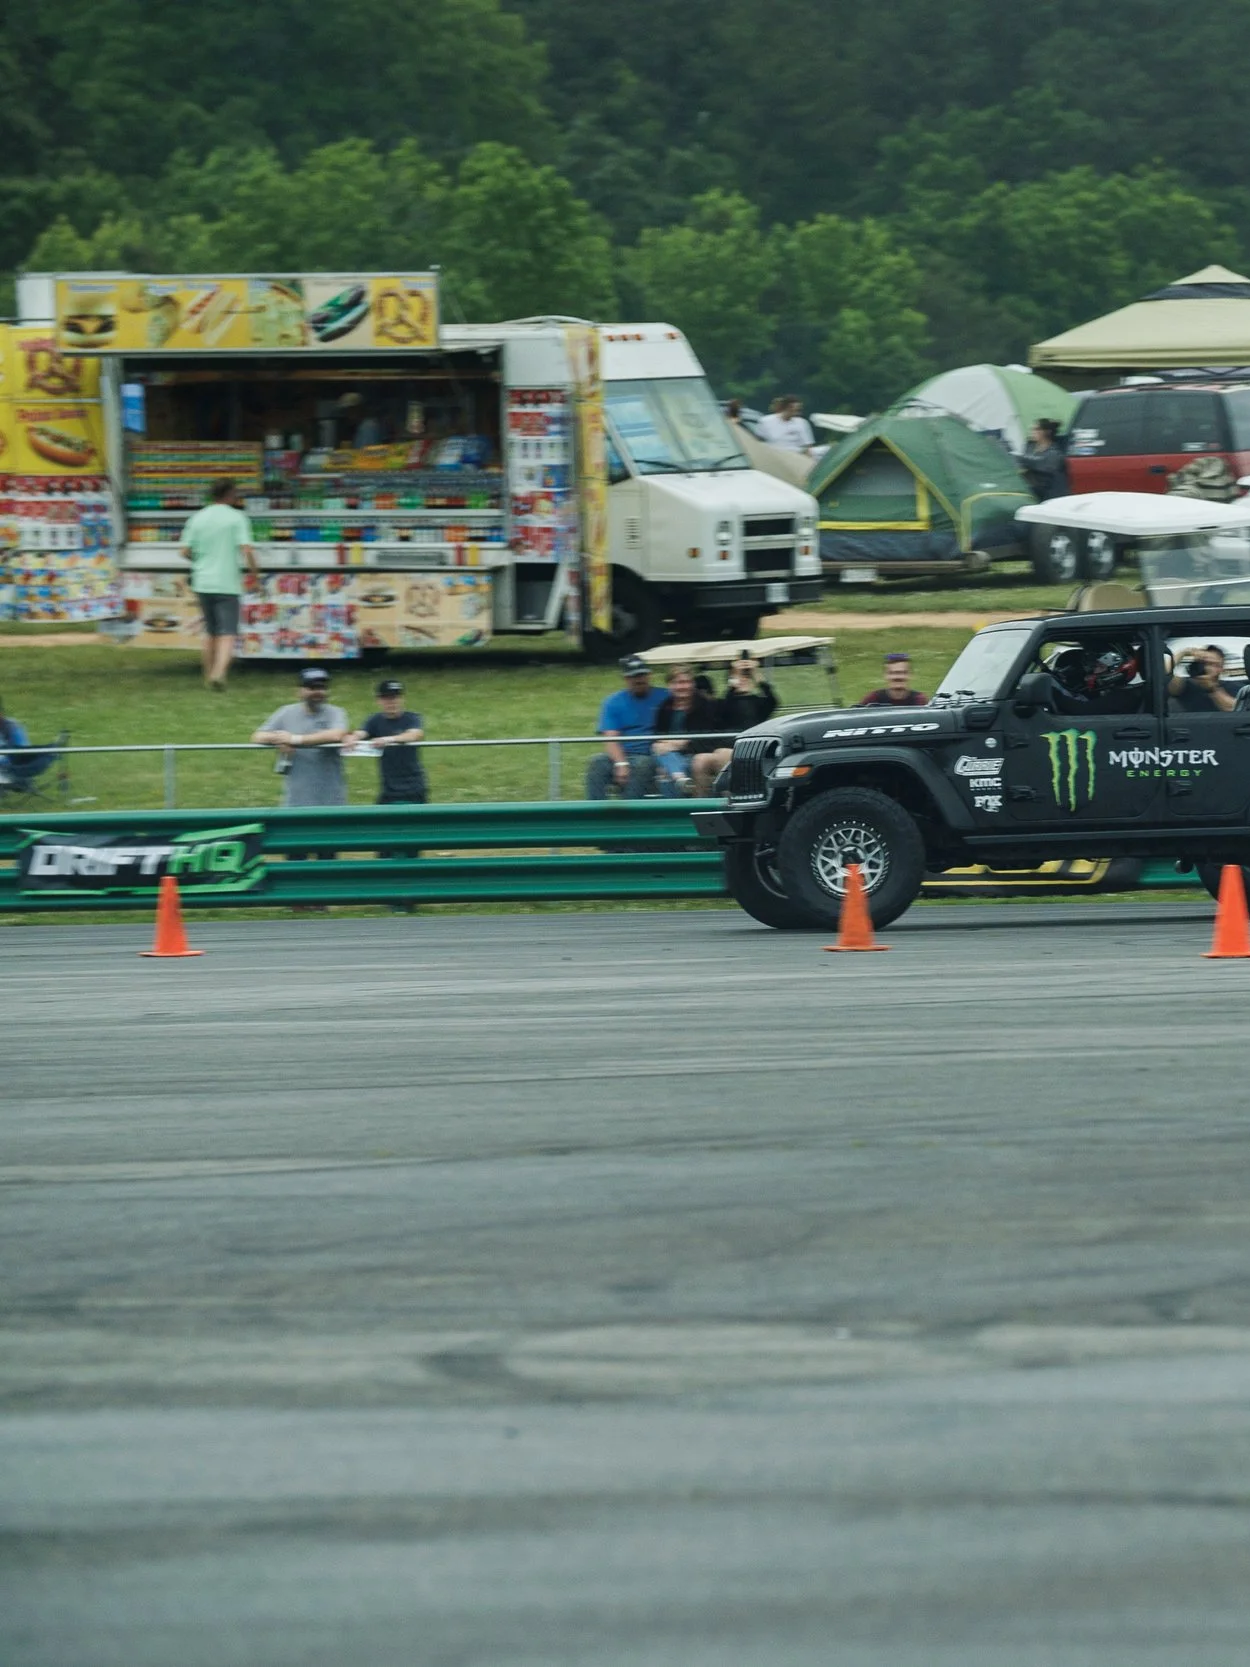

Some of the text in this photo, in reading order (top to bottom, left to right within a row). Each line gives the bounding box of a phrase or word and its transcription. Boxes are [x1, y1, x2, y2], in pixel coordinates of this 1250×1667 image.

[823, 723, 940, 738] NITTO
[1109, 747, 1219, 768] MONSTER
[1126, 769, 1203, 777] ENERGY
[969, 778, 1002, 787] KMC
